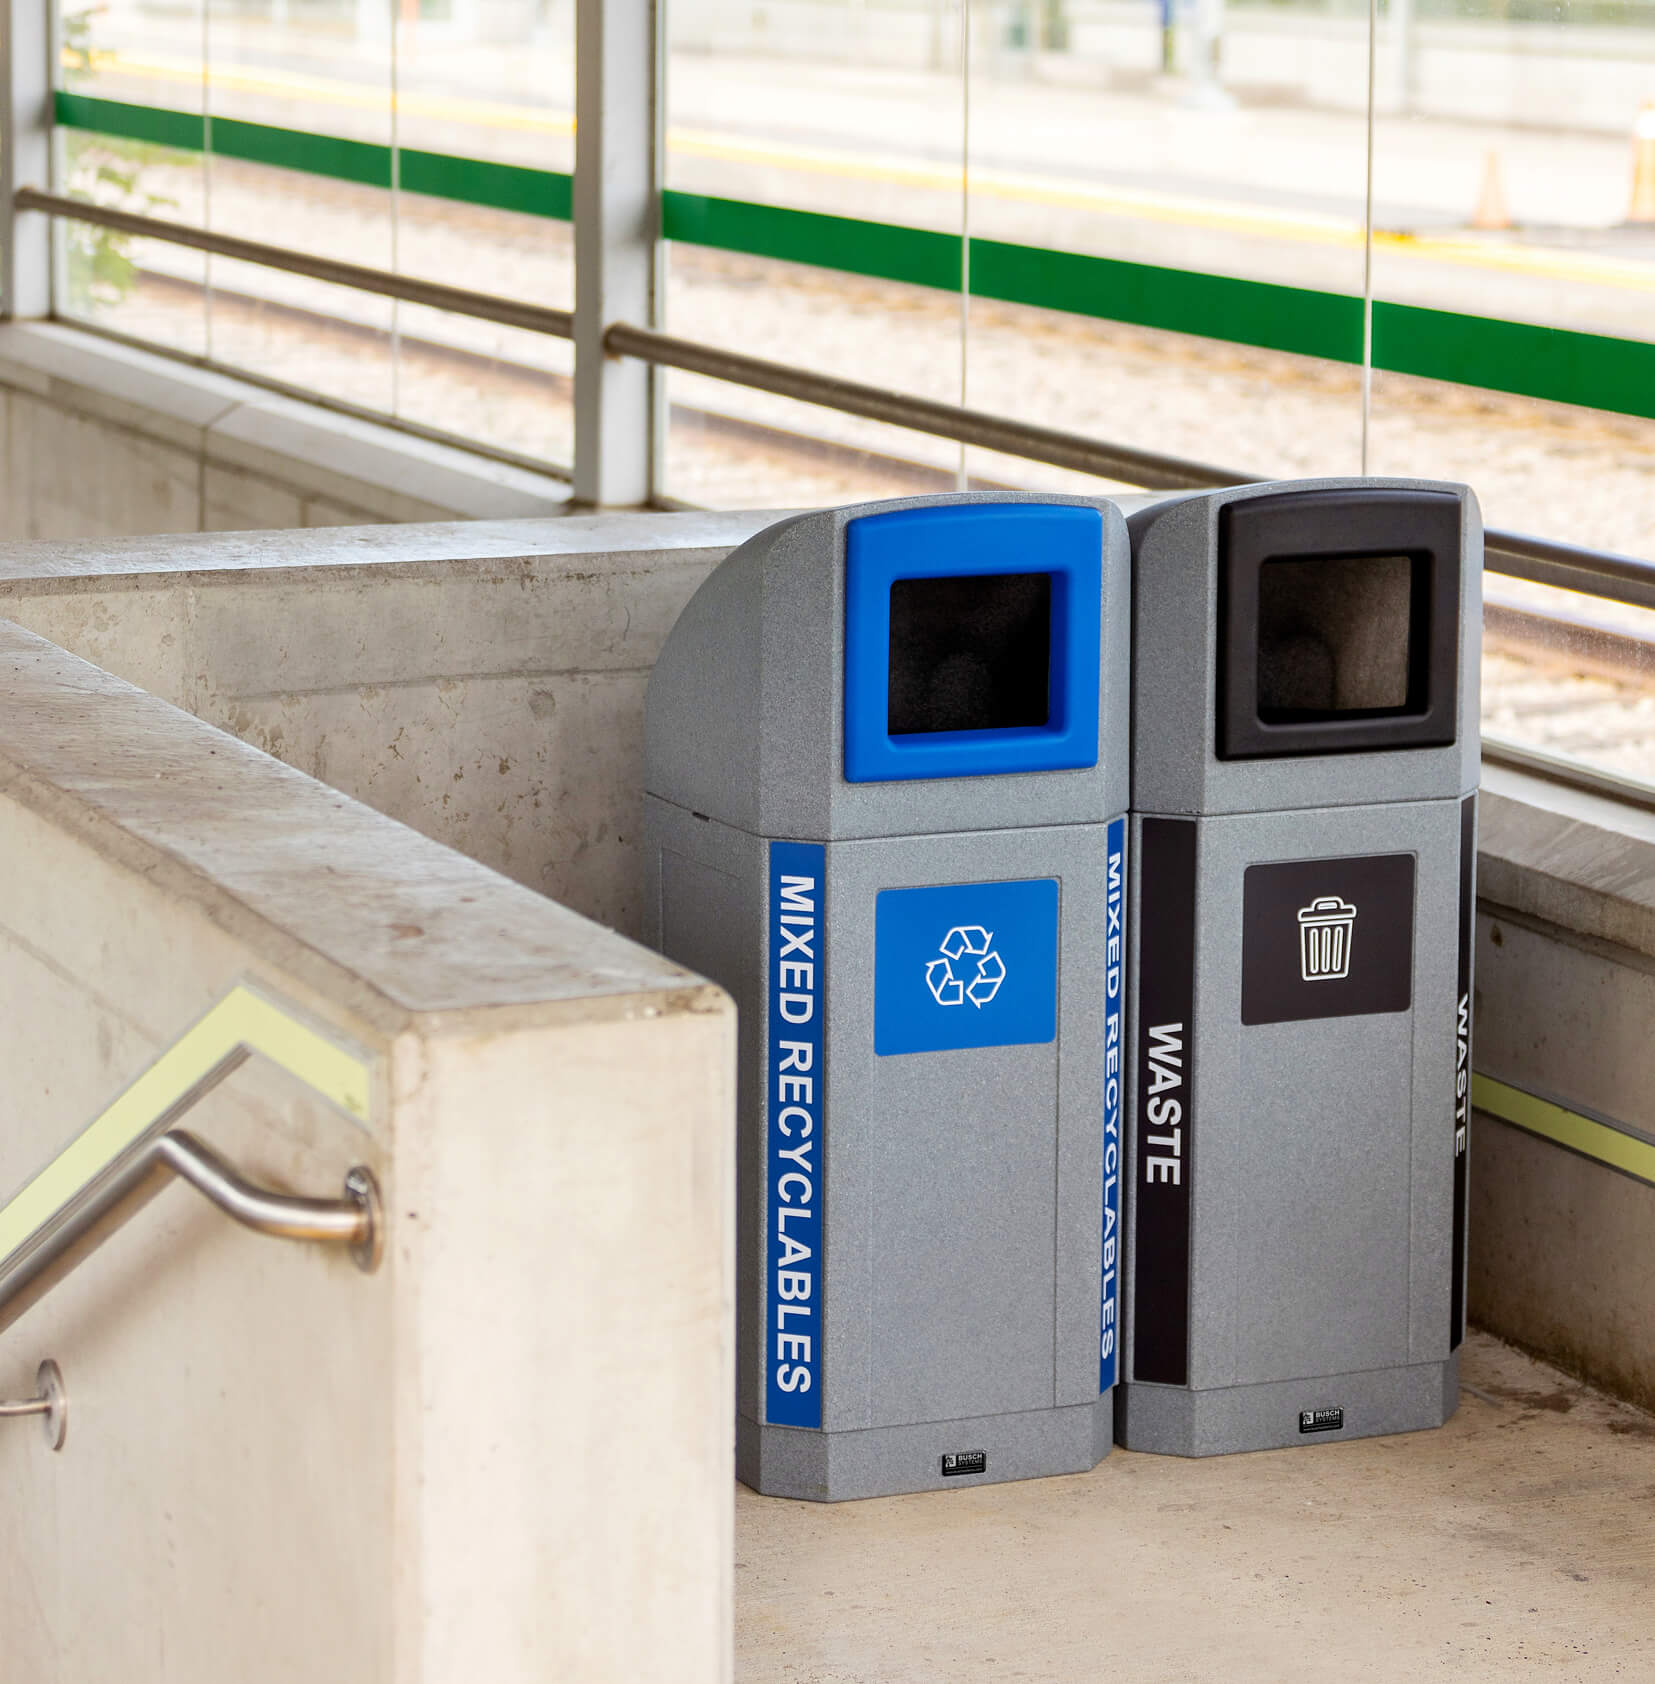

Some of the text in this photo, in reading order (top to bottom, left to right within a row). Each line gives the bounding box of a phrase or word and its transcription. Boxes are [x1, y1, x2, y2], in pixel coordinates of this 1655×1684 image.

[776, 875, 815, 1394] MIXED RECYCLABLES
[1101, 852, 1121, 1360] MIXED RECYCLABLES
[1146, 1022, 1184, 1185] WASTE
[1455, 992, 1469, 1158] WASTE
[958, 1453, 983, 1461] BUSCH
[1315, 1410, 1340, 1418] BUSCH
